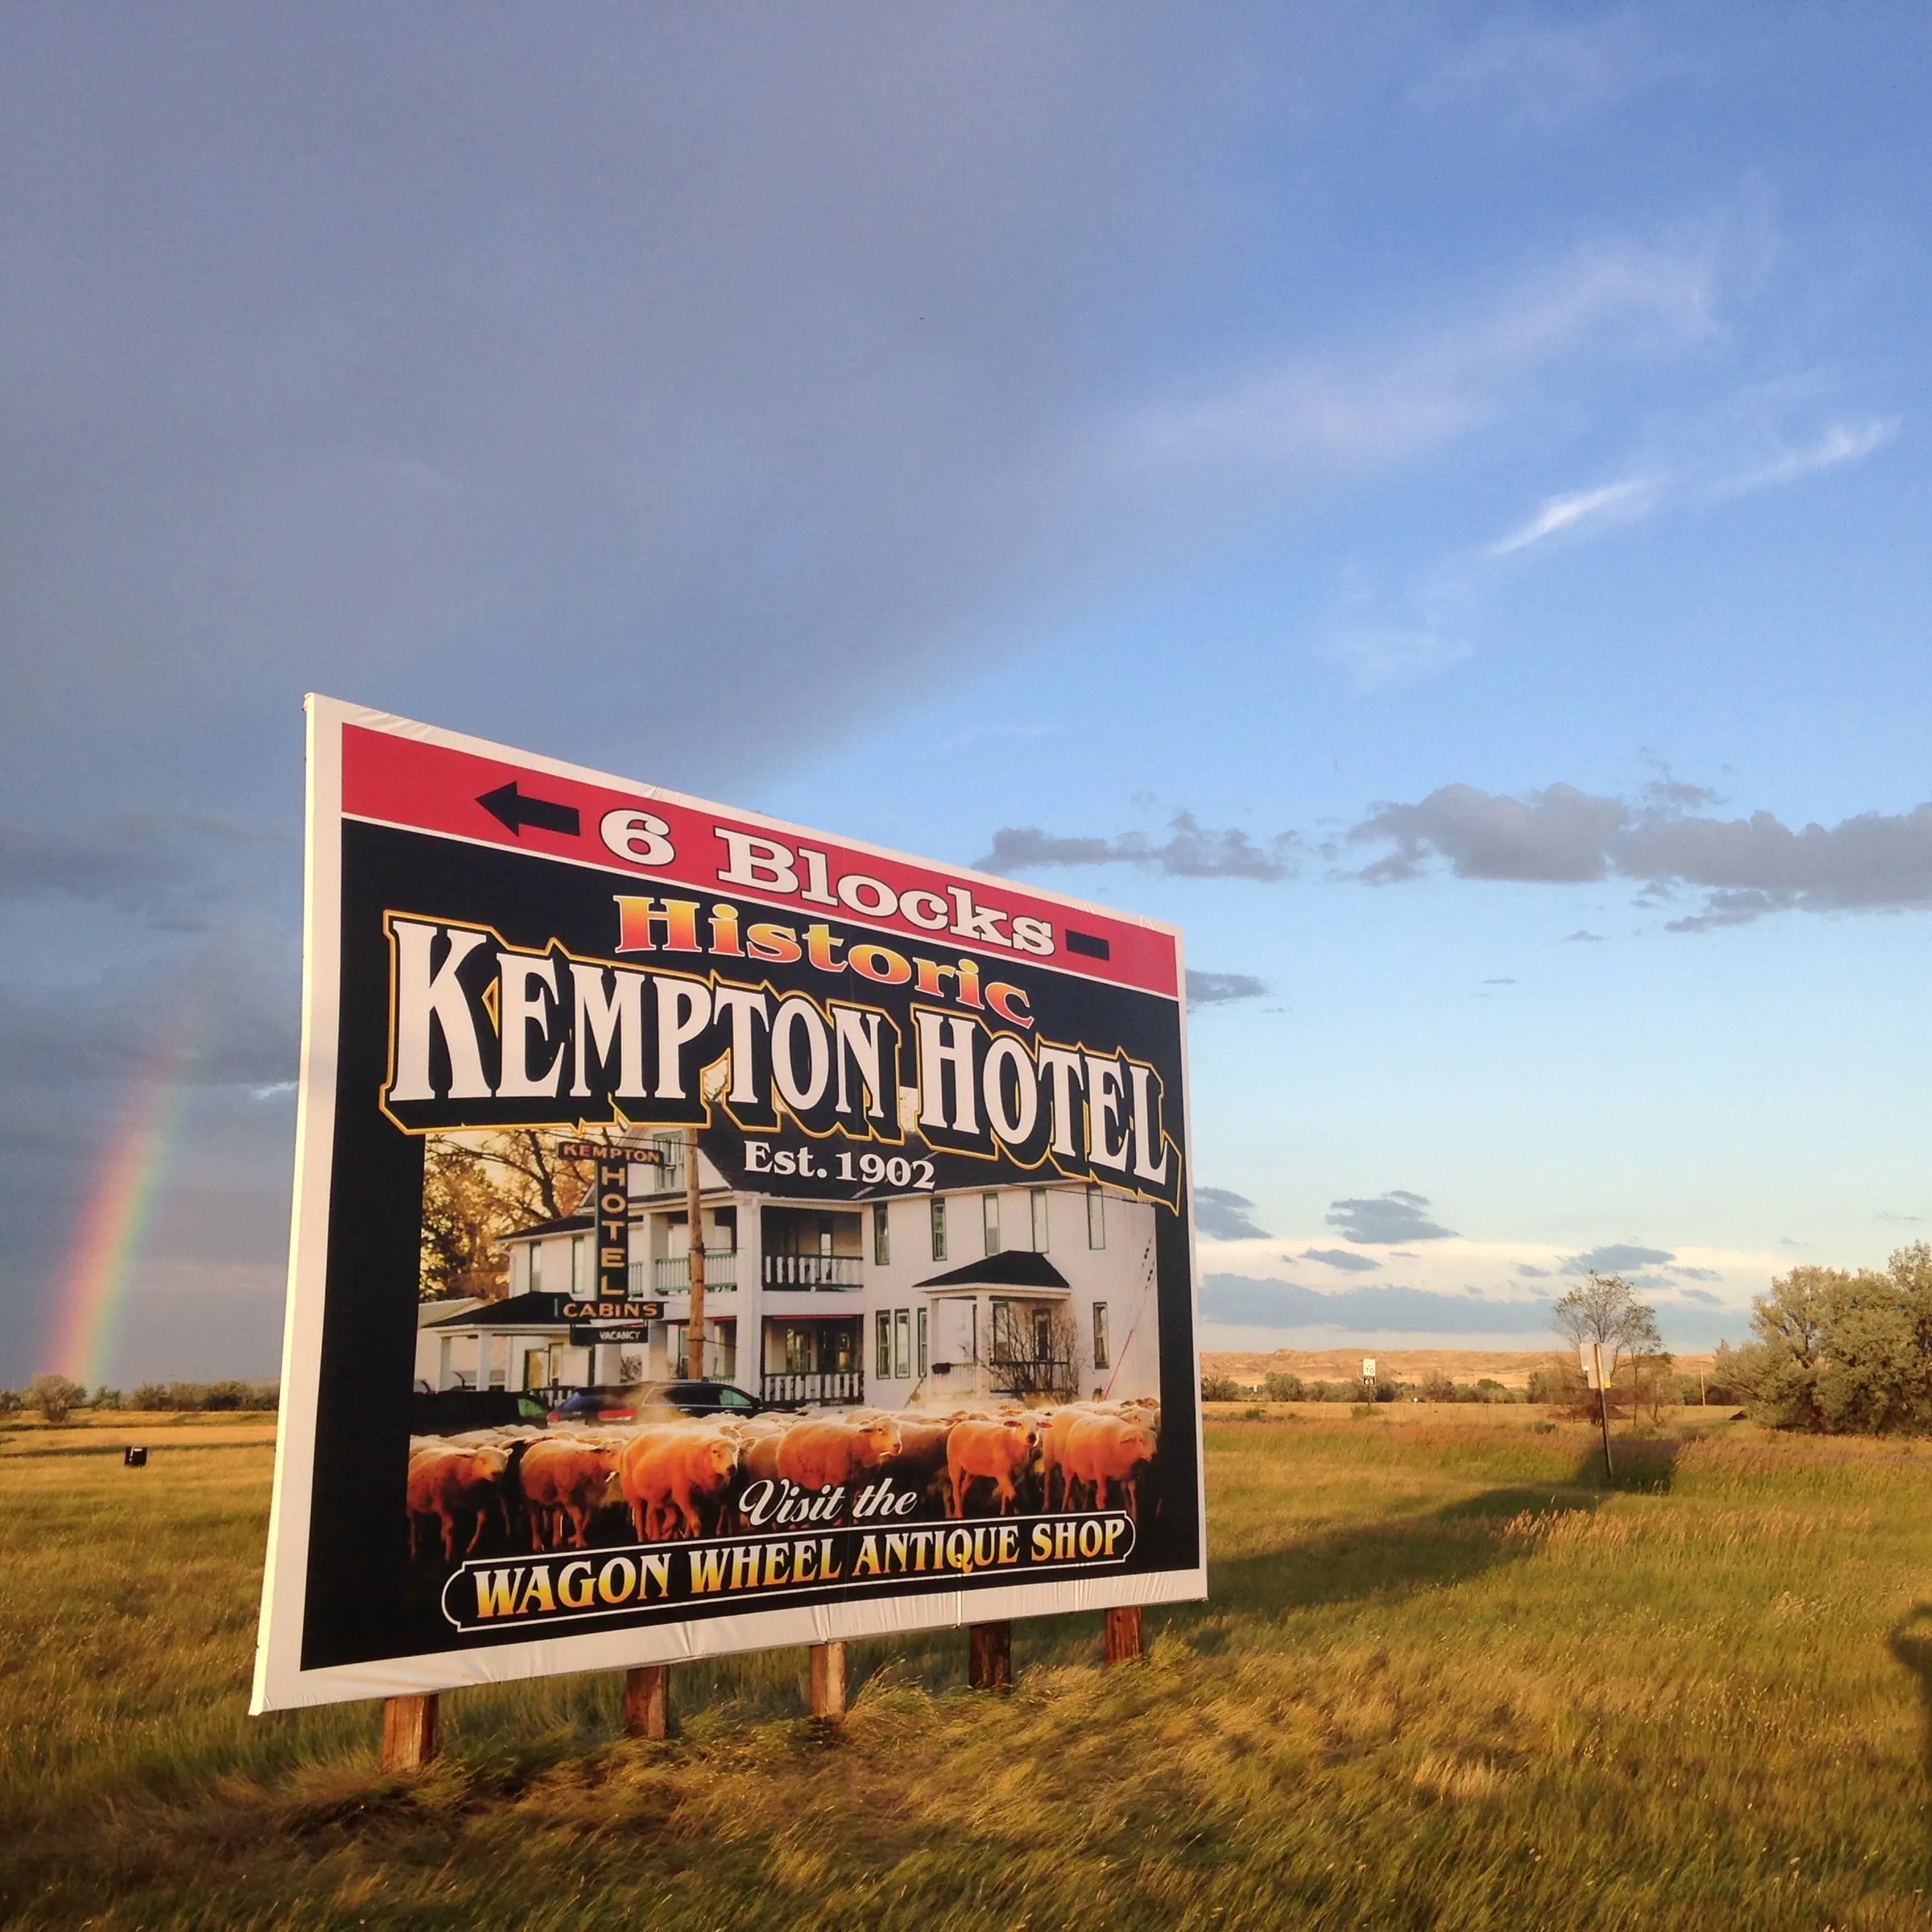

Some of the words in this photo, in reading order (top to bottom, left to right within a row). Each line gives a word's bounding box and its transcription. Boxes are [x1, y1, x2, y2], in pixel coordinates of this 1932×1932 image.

[599, 808, 676, 867] 6
[713, 825, 1055, 957] Blocks
[613, 894, 1034, 1030] Historic
[389, 920, 885, 1119] KEMPTON
[914, 1009, 1170, 1186] HOTEL
[563, 1142, 660, 1163] KEMPTON
[743, 1140, 828, 1179] Est.
[835, 1152, 936, 1191] 1902
[601, 1166, 626, 1297] HOTEL
[563, 1302, 658, 1319] CABINS
[599, 1329, 641, 1341] VACANCY
[738, 1477, 847, 1526] Visit
[851, 1476, 919, 1519] the
[473, 1552, 673, 1619] WAGON
[687, 1538, 842, 1595] WHEEL
[851, 1525, 1020, 1574] ANTIQUE
[1030, 1517, 1126, 1561] SHOP
